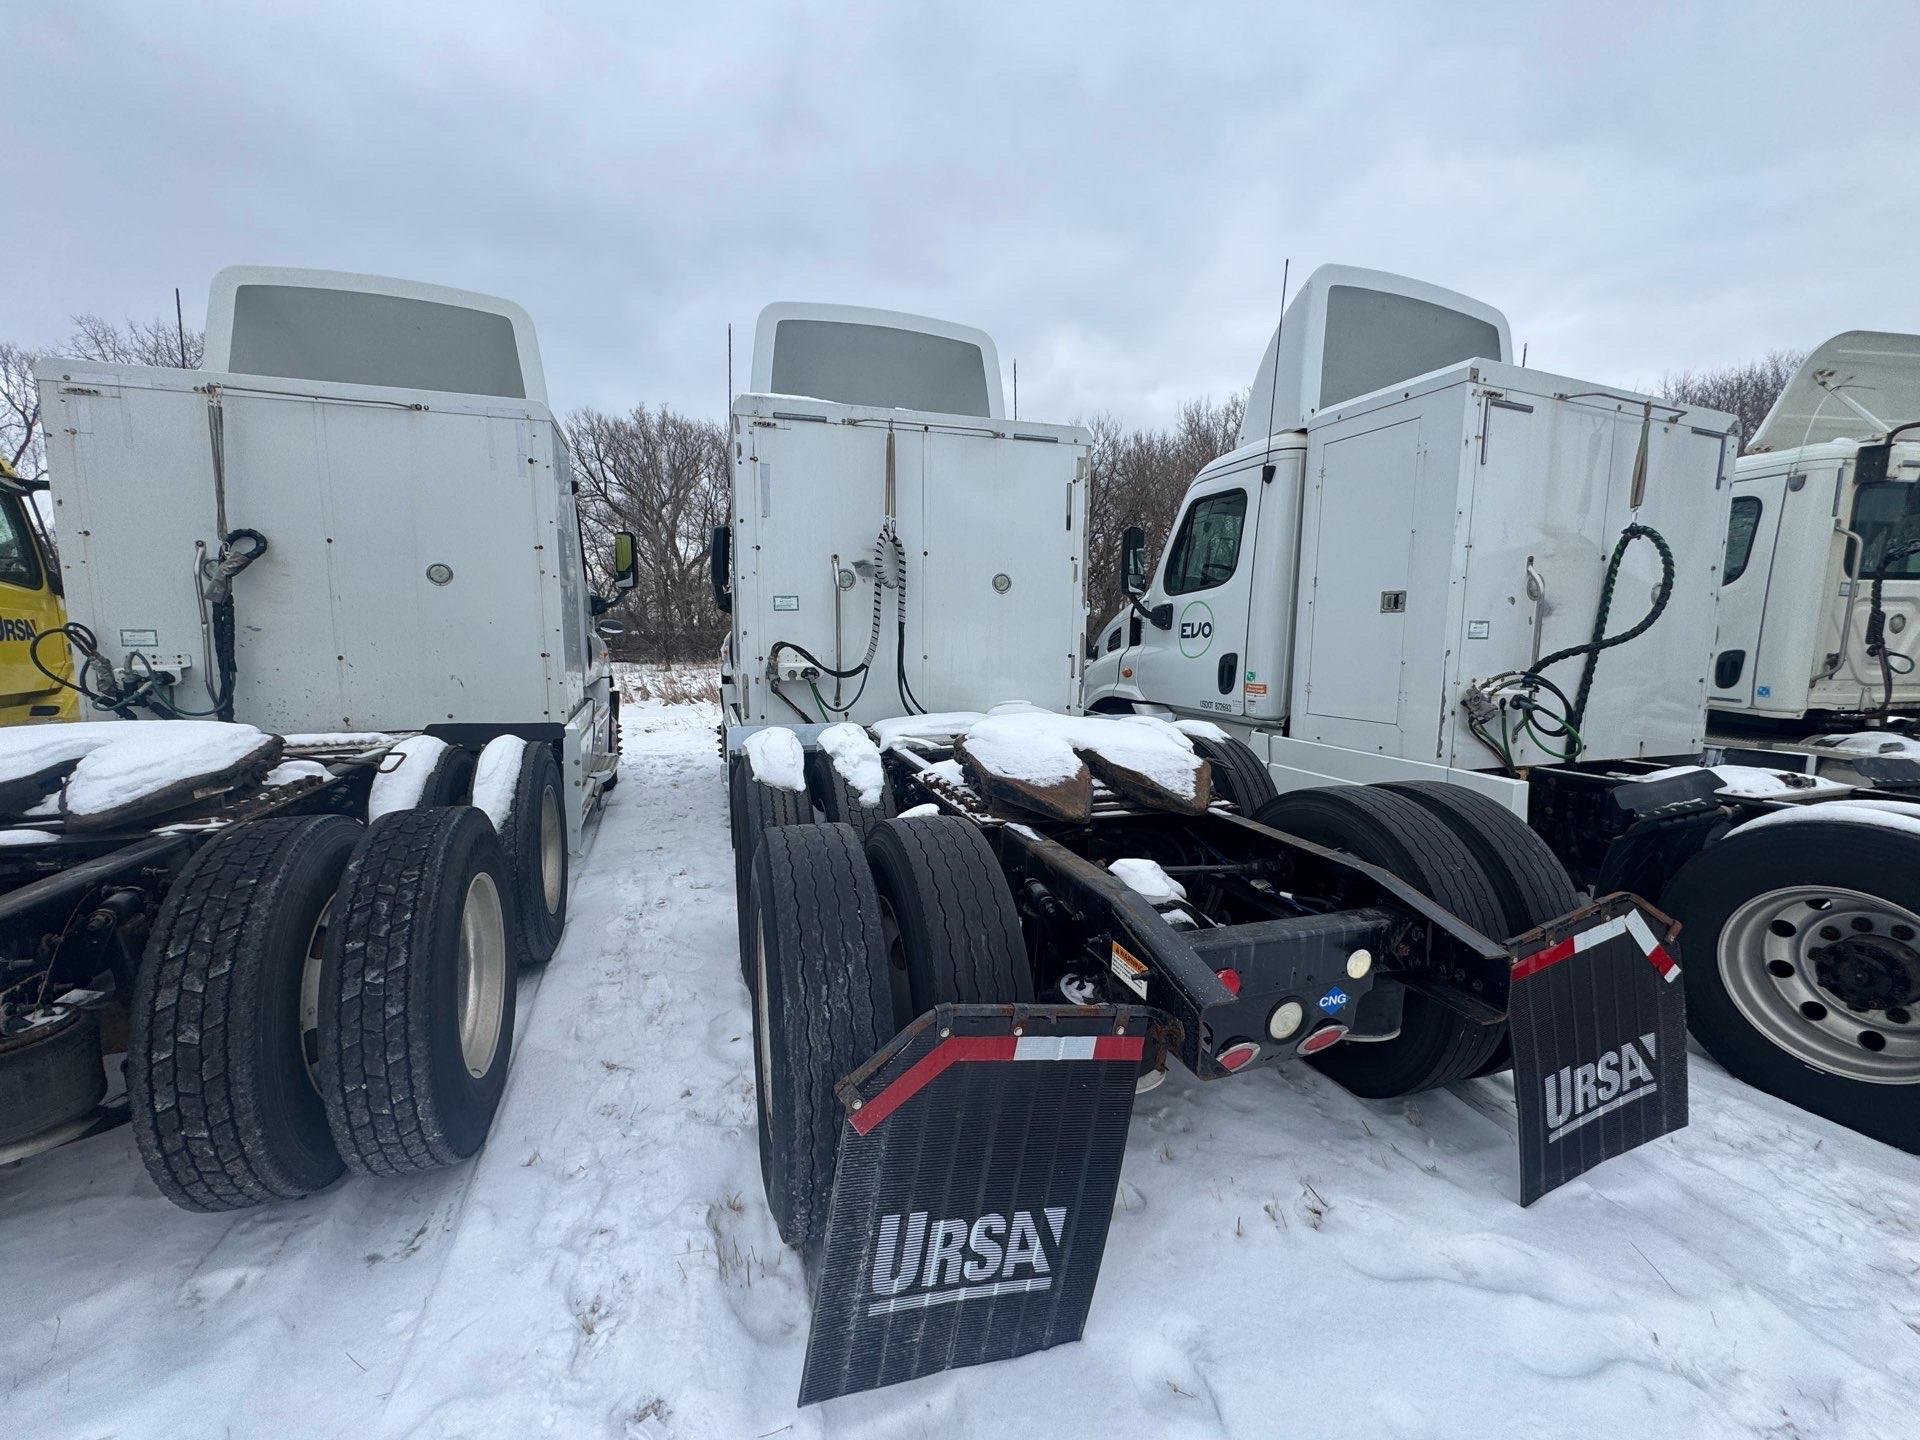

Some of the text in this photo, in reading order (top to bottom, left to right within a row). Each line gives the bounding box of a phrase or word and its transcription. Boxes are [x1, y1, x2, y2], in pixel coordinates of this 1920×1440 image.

[1181, 622, 1212, 638] EVO
[1319, 993, 1346, 1007] CNG
[1544, 1041, 1655, 1129] URSA
[872, 1211, 1051, 1294] URSA
